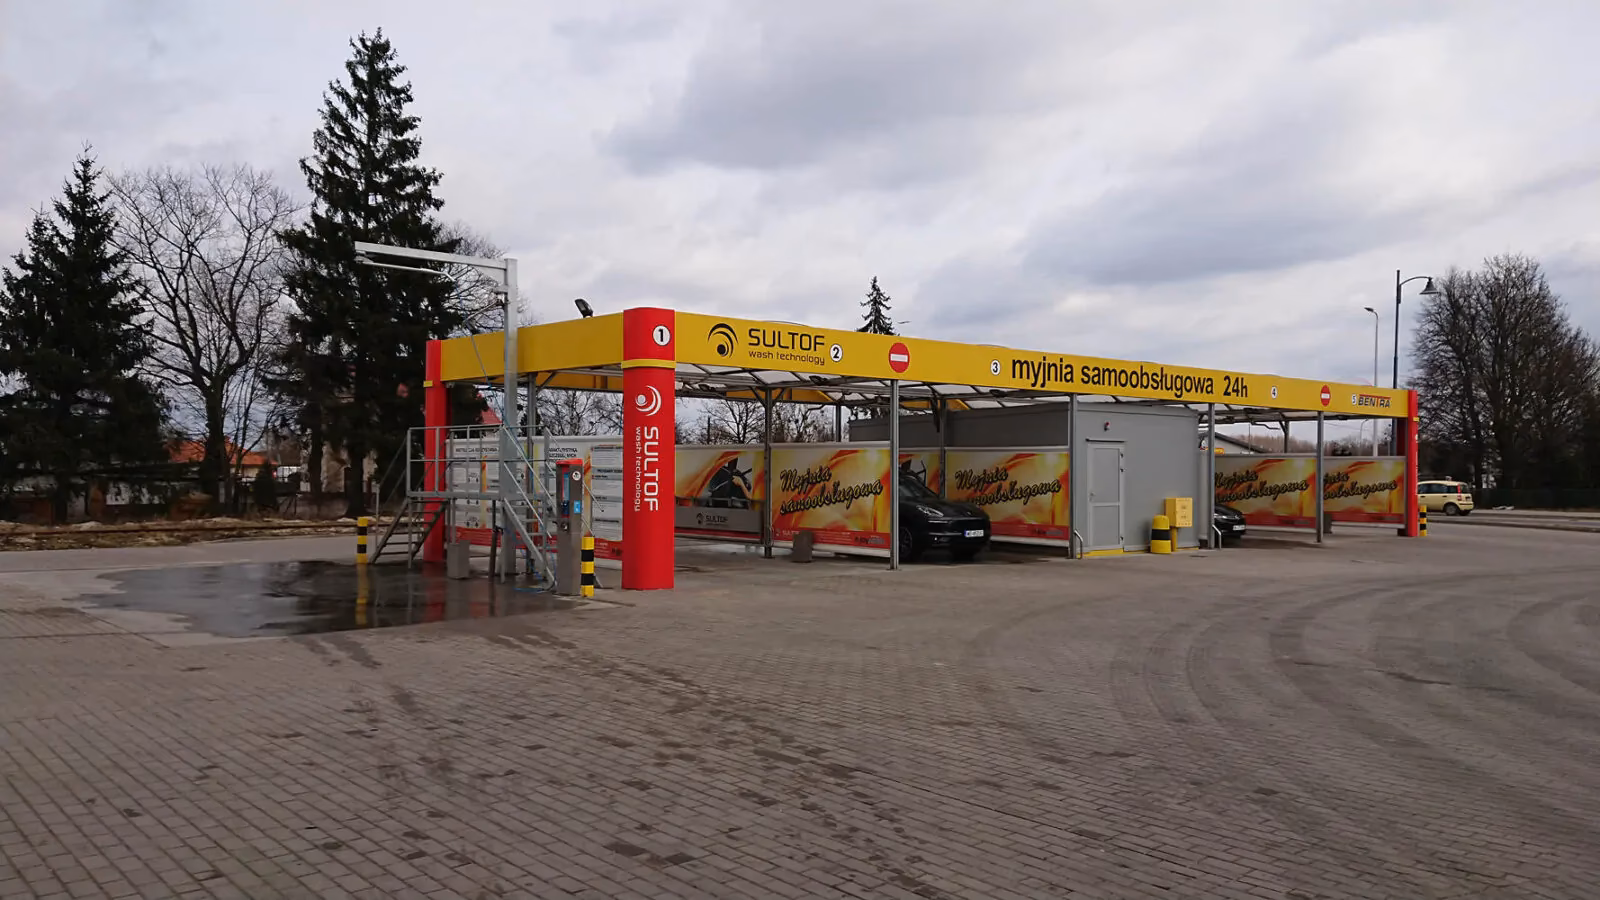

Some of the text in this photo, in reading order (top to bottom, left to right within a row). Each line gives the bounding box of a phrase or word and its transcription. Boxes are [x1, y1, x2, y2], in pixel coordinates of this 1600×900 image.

[658, 329, 665, 342] 1
[747, 328, 825, 351] SULTOF
[748, 351, 825, 365] wash technology
[832, 346, 840, 358] 2
[992, 362, 998, 373] 3
[1011, 356, 1248, 398] myjnia samoobsługowa 24h
[643, 426, 659, 511] SULTOF
[780, 466, 832, 494] Myjnia
[955, 466, 1008, 492] Myjnia
[780, 479, 883, 515] samoobsługowa
